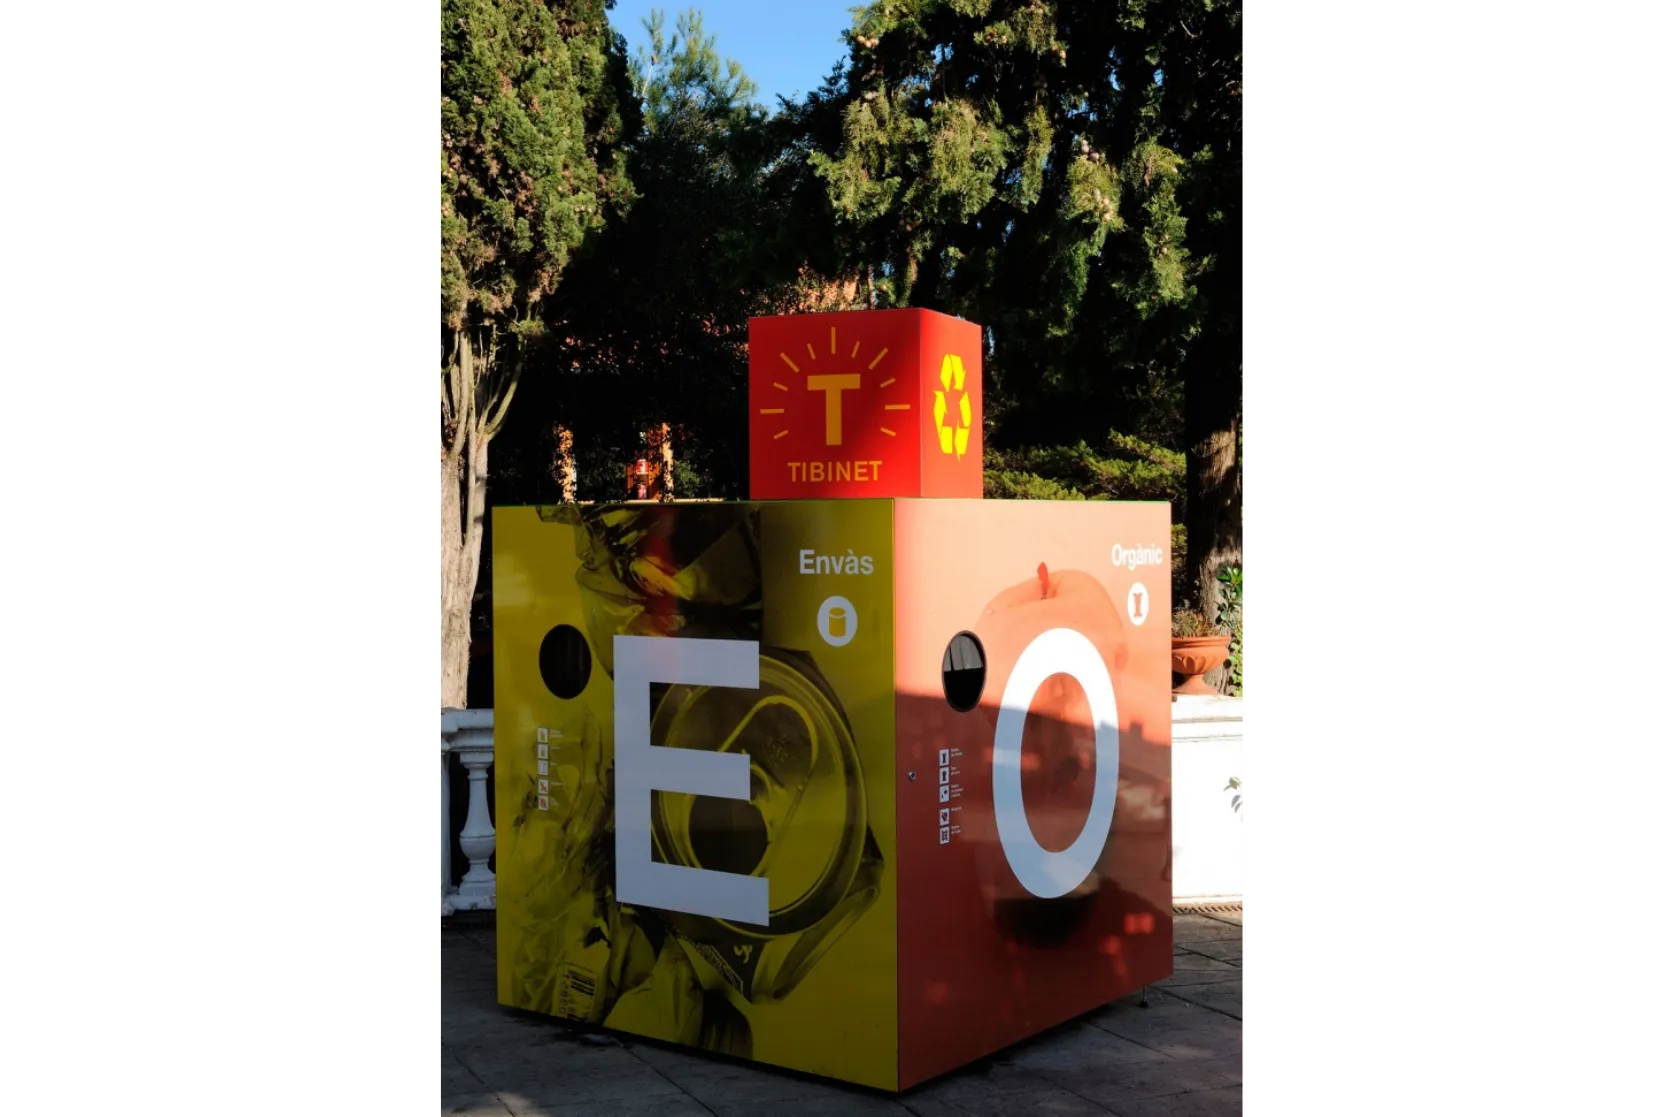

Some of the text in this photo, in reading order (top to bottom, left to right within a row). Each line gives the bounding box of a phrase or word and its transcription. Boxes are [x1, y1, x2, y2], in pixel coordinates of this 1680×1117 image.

[807, 374, 861, 446] T
[787, 460, 883, 483] TIBINET
[799, 548, 874, 576] Envàs
[1111, 542, 1164, 572] Orgànic
[613, 635, 770, 927] E
[993, 627, 1119, 899] O
